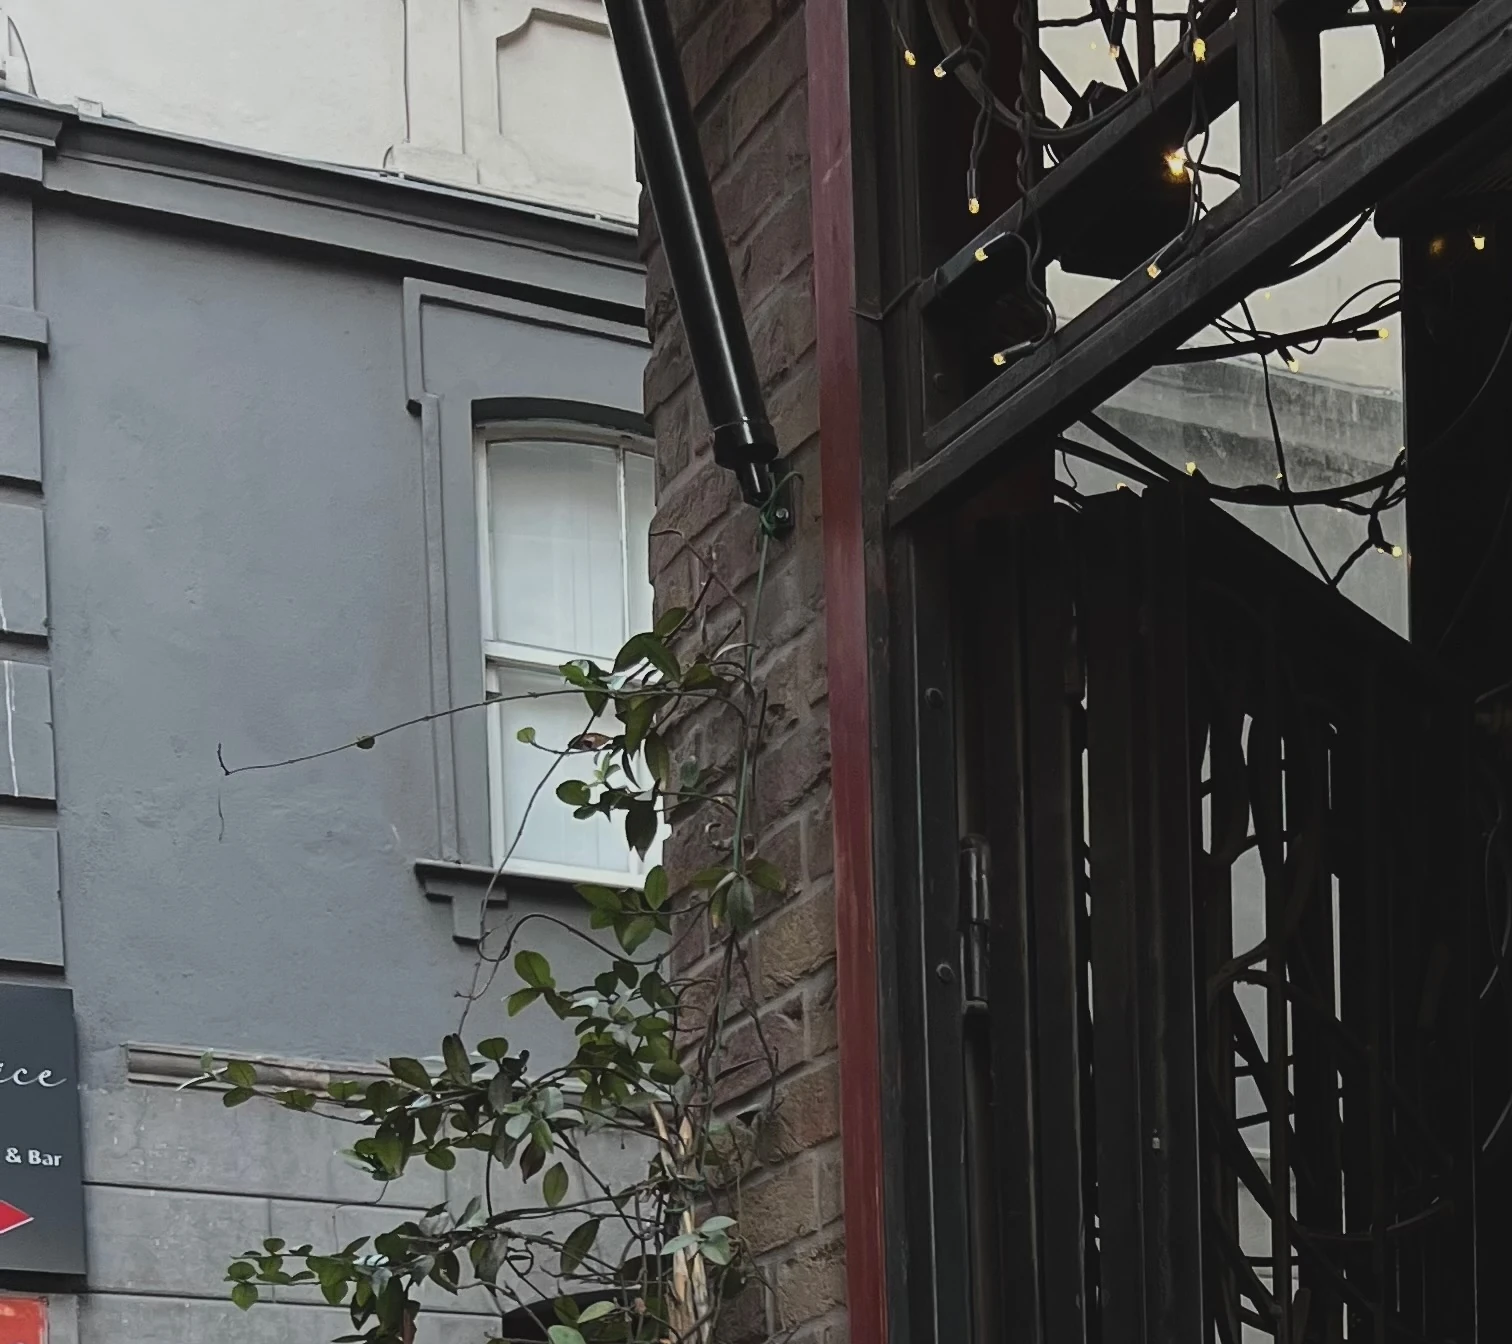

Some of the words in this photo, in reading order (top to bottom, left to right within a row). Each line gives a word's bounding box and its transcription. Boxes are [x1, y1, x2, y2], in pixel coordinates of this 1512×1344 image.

[0, 1062, 67, 1087] ce
[5, 1147, 22, 1164] &
[28, 1149, 62, 1167] Bar
